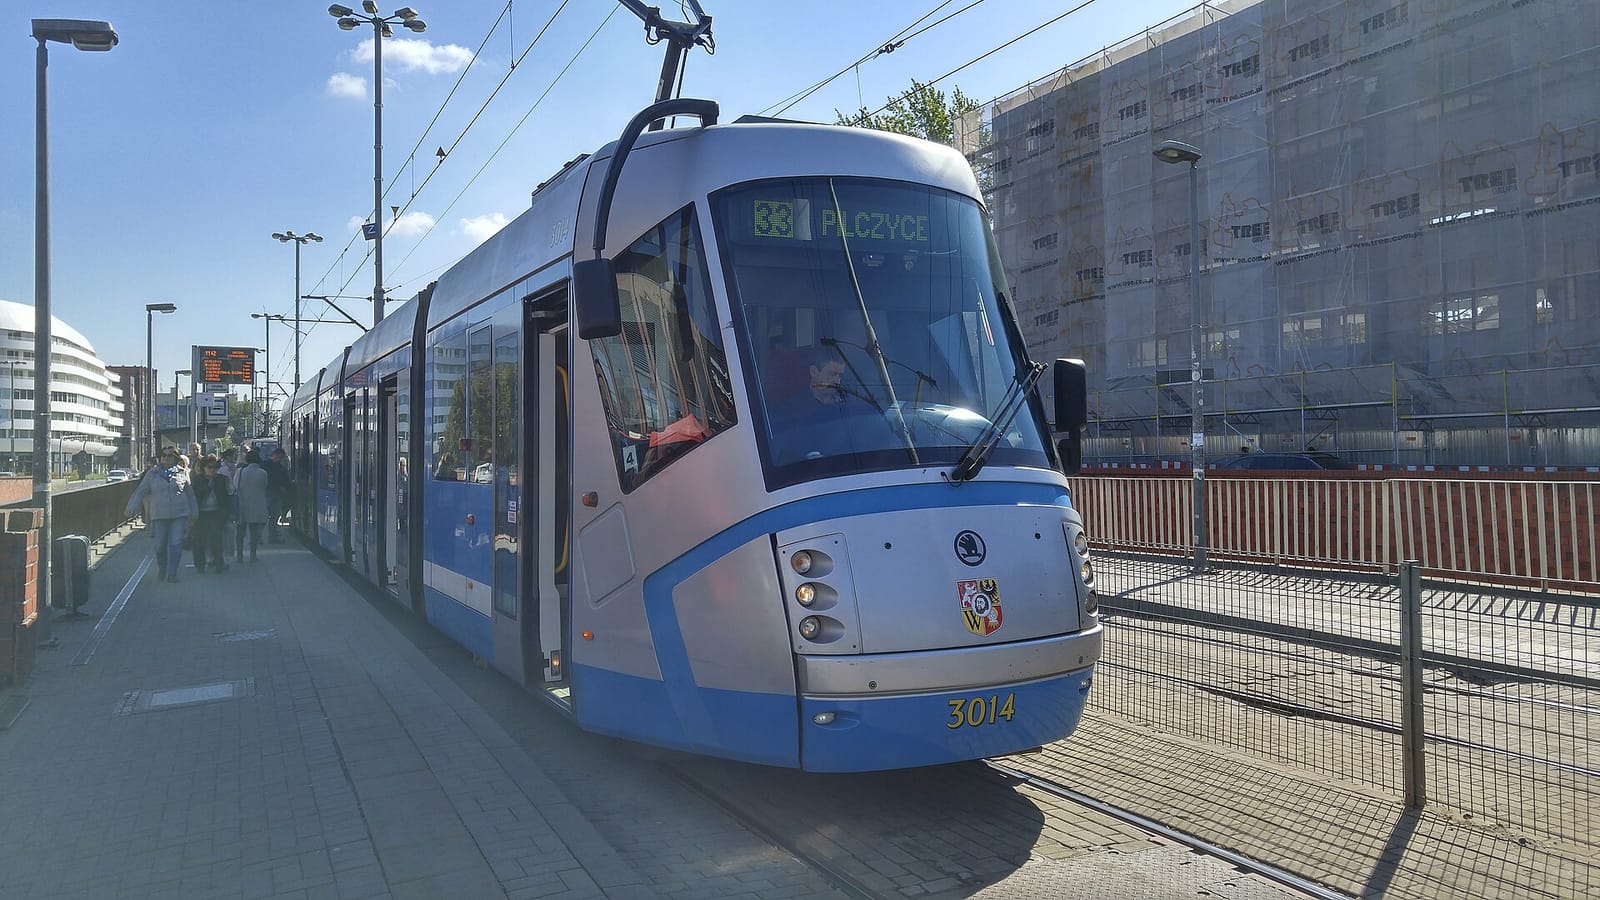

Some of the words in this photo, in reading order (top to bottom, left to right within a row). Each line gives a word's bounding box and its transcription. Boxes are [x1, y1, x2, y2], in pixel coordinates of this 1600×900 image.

[1288, 33, 1329, 62] TREE
[1222, 54, 1260, 78] TREE
[1118, 99, 1147, 120] TREE
[1457, 168, 1516, 193] TREE
[1369, 192, 1419, 218] TREE
[754, 200, 793, 237] 33
[822, 209, 928, 241] PILCZYCE
[1231, 222, 1270, 239] TREE
[1297, 212, 1340, 234] TREE
[1033, 232, 1058, 250] TREE
[1122, 249, 1153, 265] TREE
[1076, 267, 1104, 283] TREE
[1034, 309, 1059, 327] TREE
[626, 452, 635, 465] 4
[963, 610, 982, 631] W
[946, 692, 1016, 729] 3014
